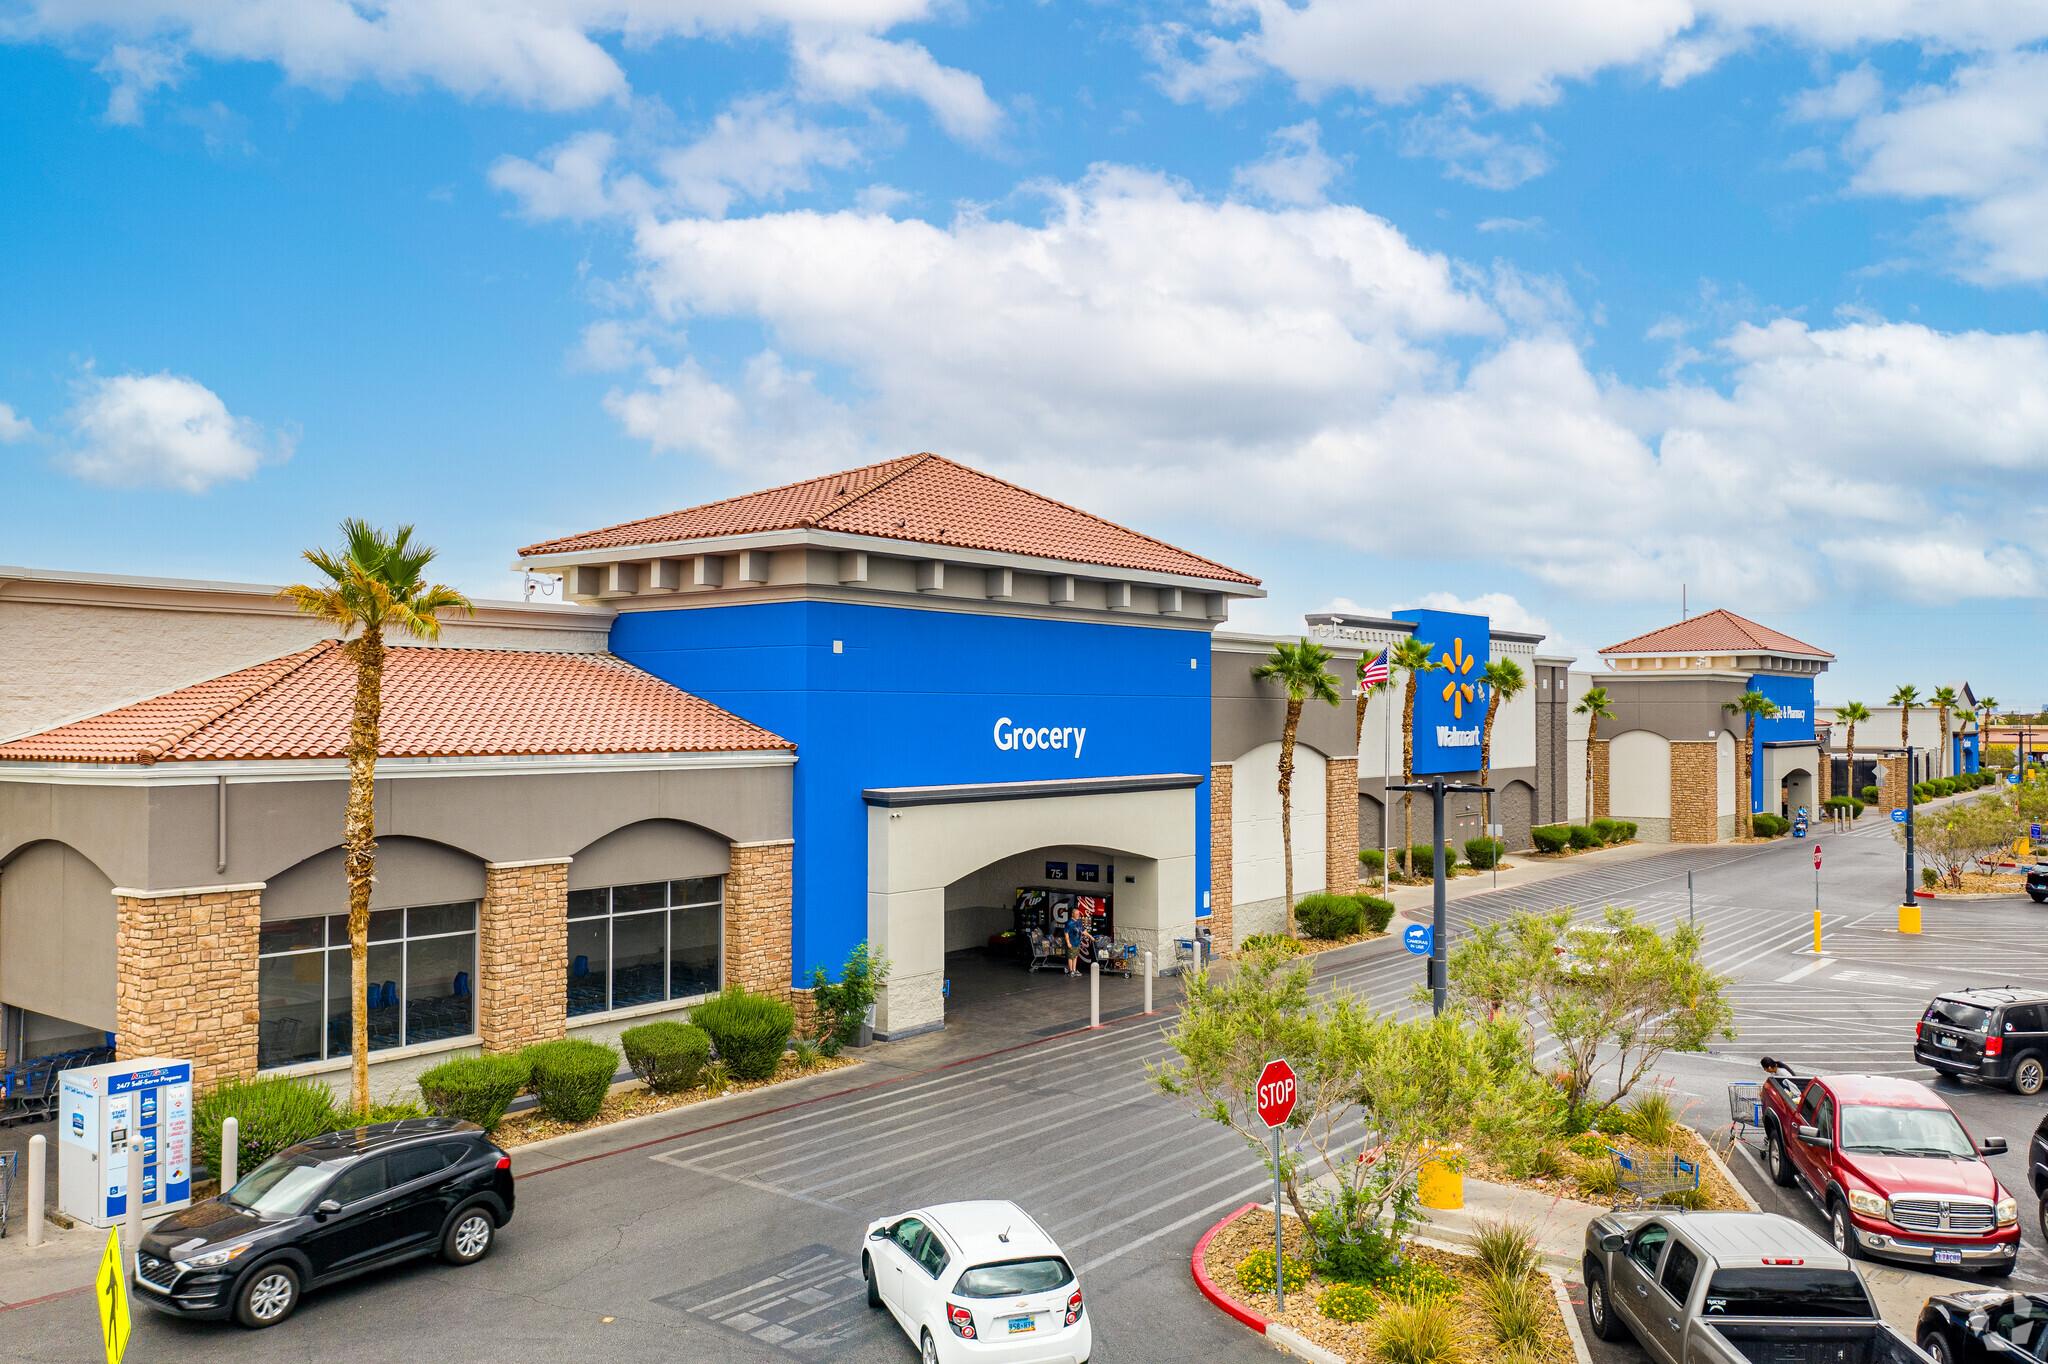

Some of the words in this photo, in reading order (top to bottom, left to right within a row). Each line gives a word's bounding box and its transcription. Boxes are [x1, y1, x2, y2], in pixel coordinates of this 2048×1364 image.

[1787, 706, 1806, 723] Pharmacy
[993, 717, 1087, 759] Grocery
[1436, 725, 1480, 747] Walmart
[1052, 902, 1069, 923] G
[1407, 938, 1429, 946] CAMERAS
[116, 1081, 131, 1090] 24/7
[131, 1077, 160, 1088] Self-Serve
[160, 1074, 183, 1083] Propane
[1260, 1079, 1294, 1109] STOP
